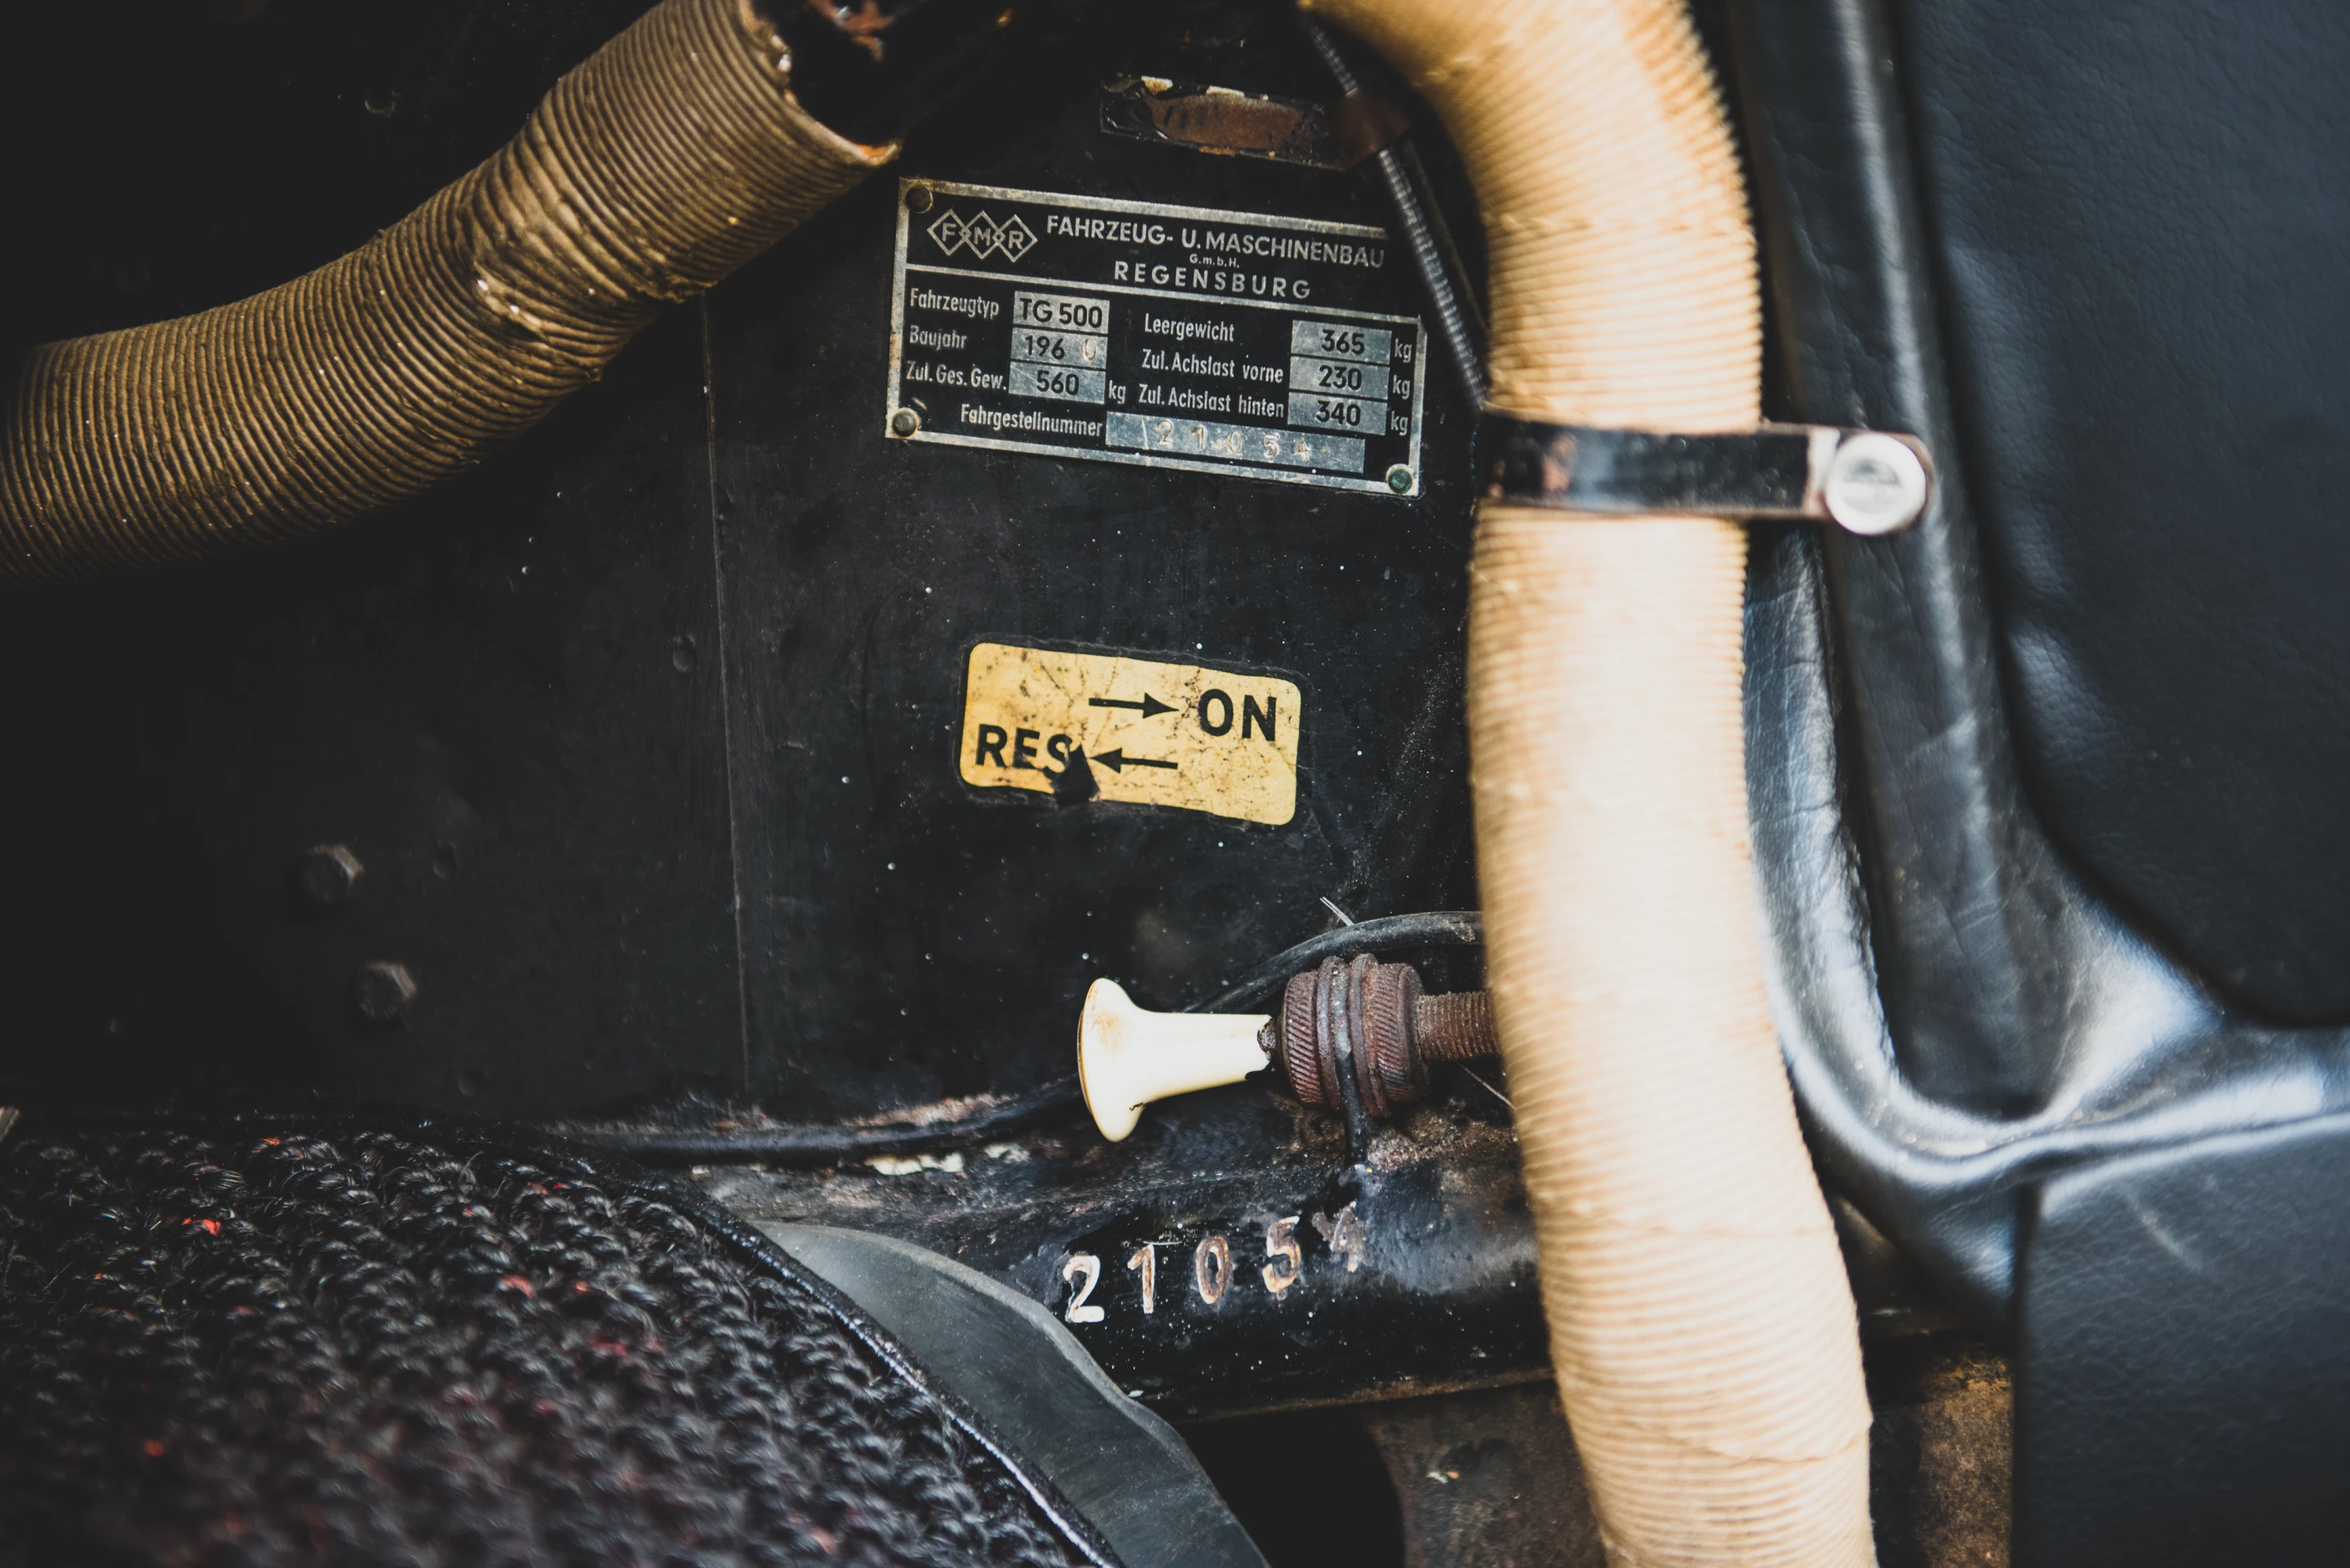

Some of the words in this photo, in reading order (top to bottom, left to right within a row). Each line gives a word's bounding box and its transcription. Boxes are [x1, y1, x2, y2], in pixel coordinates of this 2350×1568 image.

[941, 222, 1025, 250] FMR
[1045, 213, 1173, 246] FAHRZEUG-
[1188, 254, 1240, 269] G.m.b.H.
[1113, 259, 1310, 300] REGENSBURG
[910, 287, 1000, 320] Fahrzeugtyp
[1019, 297, 1053, 323] TG
[1059, 303, 1103, 328] 500
[909, 325, 968, 351] Baujahr
[1144, 313, 1235, 342] Leergewicht
[1321, 329, 1366, 355] 365
[1394, 338, 1413, 363] kg
[906, 361, 933, 382] Zul.
[935, 364, 968, 387] Ges.
[970, 367, 1008, 391] Gew.
[1142, 348, 1168, 371] Zul.
[1172, 353, 1235, 378] Achslast
[1242, 363, 1284, 384] vorne
[1318, 365, 1363, 392] 230
[1035, 370, 1080, 396] 560
[1108, 379, 1127, 405] kg
[1392, 374, 1412, 401] kg
[1138, 383, 1165, 406] Zul.
[1168, 388, 1231, 413] Achslast
[1239, 395, 1284, 419] hinten
[1315, 401, 1362, 427] 340
[960, 404, 1104, 436] Fahrgestellnummer
[1390, 410, 1410, 436] kg
[1199, 689, 1278, 742] ON
